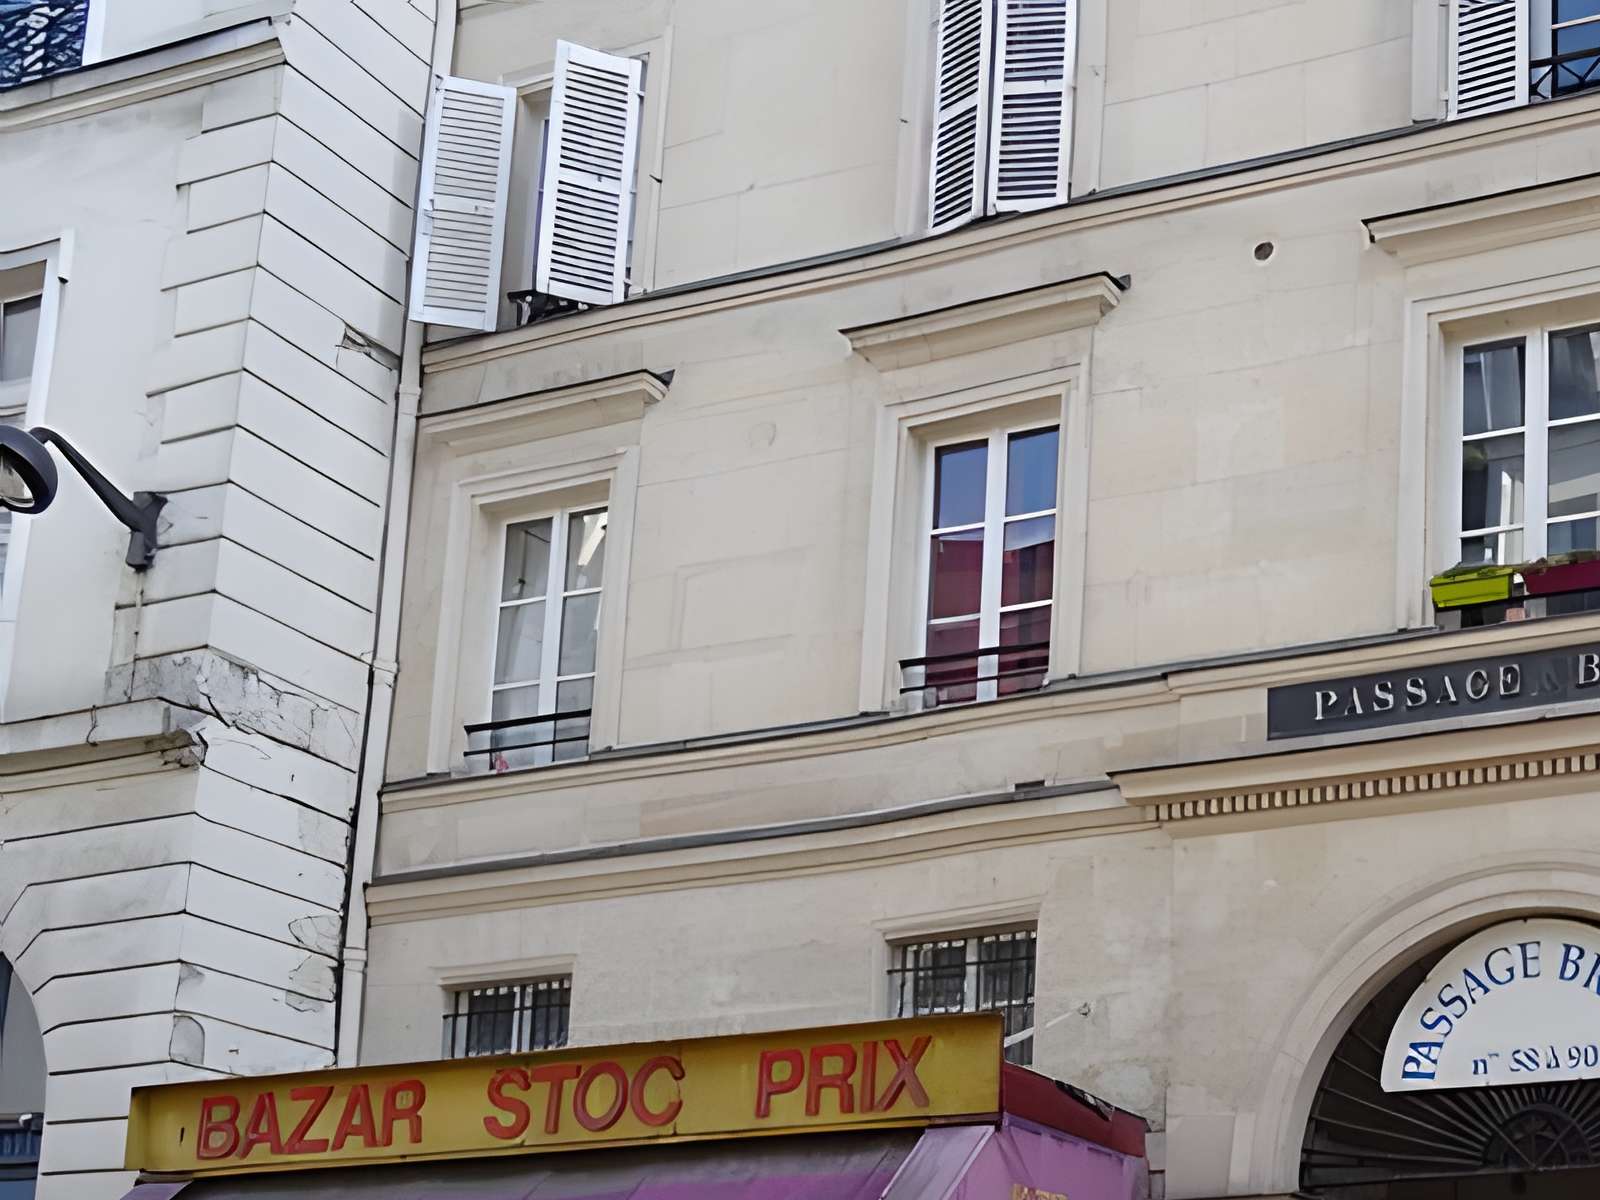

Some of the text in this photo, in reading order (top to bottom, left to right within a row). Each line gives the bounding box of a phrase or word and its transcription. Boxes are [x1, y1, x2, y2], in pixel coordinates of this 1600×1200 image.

[1314, 663, 1521, 721] PASSAGE
[1401, 941, 1542, 1080] PASSAGE
[196, 1035, 933, 1160] BAZAR STOC PRIX
[1567, 1045, 1599, 1068] 90
